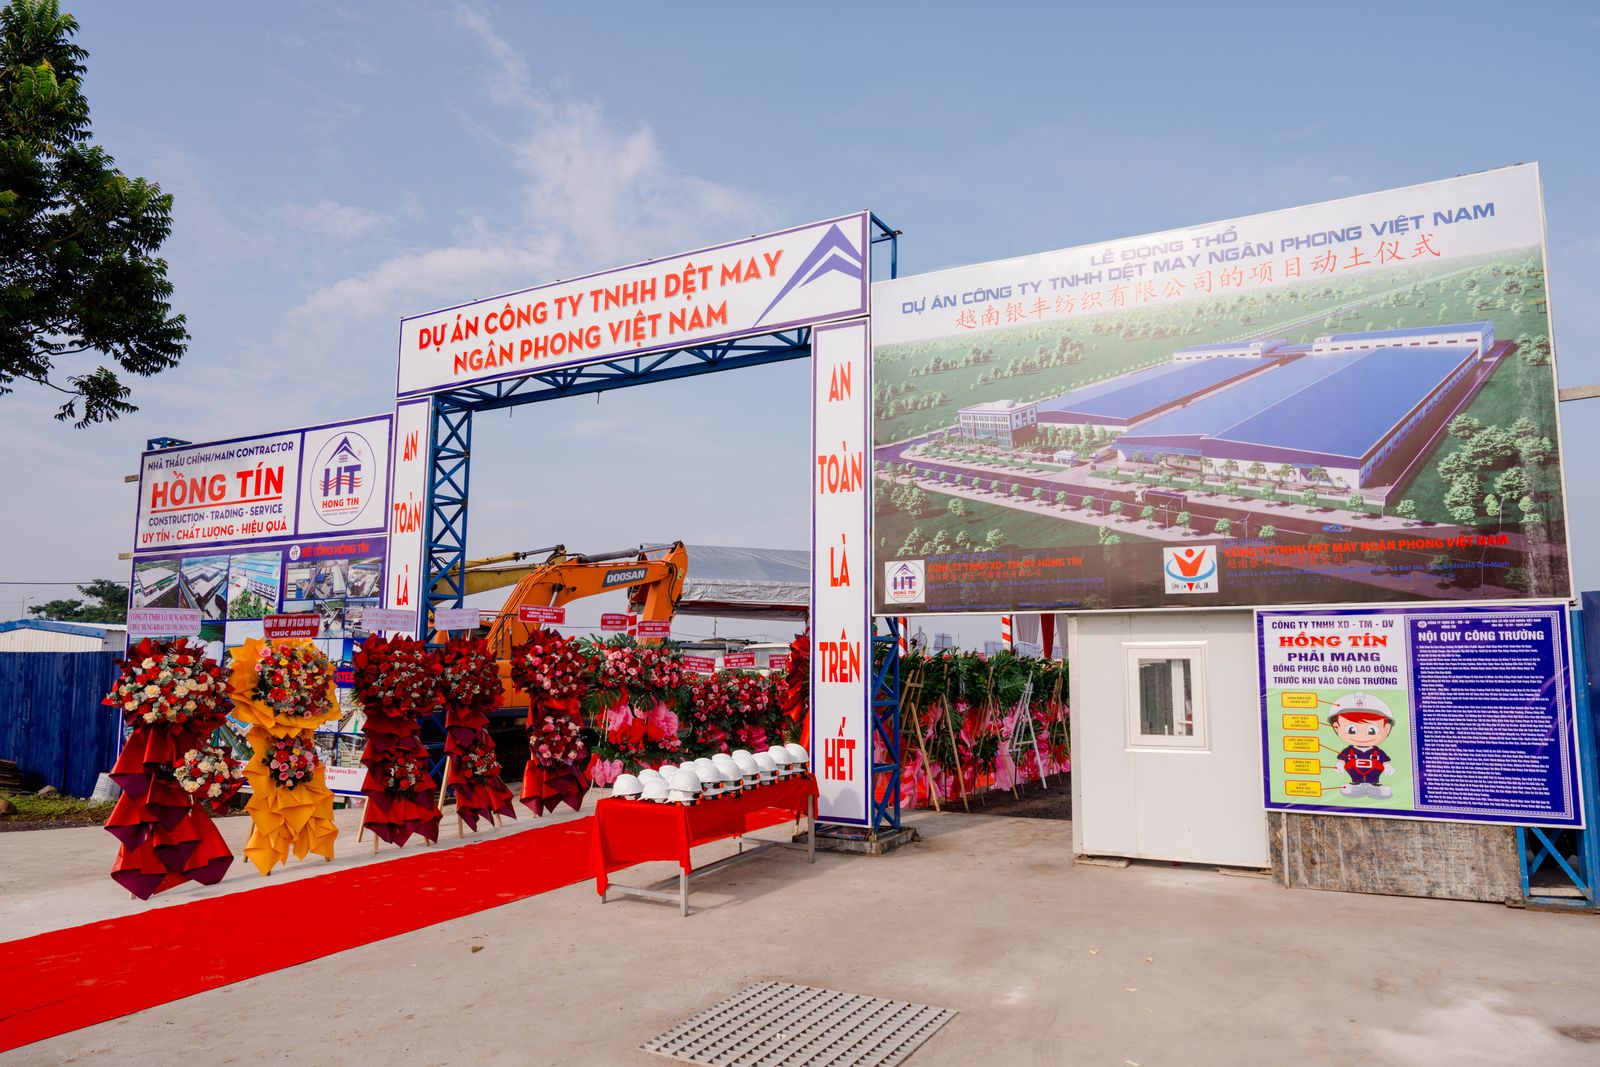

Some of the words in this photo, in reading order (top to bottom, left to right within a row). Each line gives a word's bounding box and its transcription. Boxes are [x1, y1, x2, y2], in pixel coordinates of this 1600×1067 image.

[902, 297, 926, 315] DỰ
[931, 294, 957, 311] ÁN
[962, 286, 1012, 305] CÔNG
[1018, 280, 1042, 296] TY
[1049, 270, 1102, 291] TNHH
[1108, 262, 1147, 282] DỆT
[1153, 253, 1200, 274] MAY
[1208, 241, 1273, 265] NGÂN
[1280, 226, 1362, 252] PHONG
[1370, 214, 1424, 237] VIỆT
[1433, 202, 1495, 226] NAM
[1091, 248, 1114, 267] LỄ
[1120, 240, 1183, 262] ĐỘNG
[1191, 226, 1237, 249] THỔ
[955, 233, 1441, 329] 越南银丰纺织有限公司的项目动土仪式
[419, 322, 447, 352] DỰ
[450, 314, 479, 343] ÁN
[484, 301, 548, 335] CÔNG
[554, 292, 584, 320] TY
[590, 277, 657, 313] TNHH
[664, 262, 713, 301] DỆT
[720, 250, 784, 287] MAY
[453, 339, 514, 375] NGÂN
[519, 325, 601, 362] PHONG
[608, 309, 662, 347] VIỆT
[669, 299, 728, 335] NAM
[829, 362, 852, 402] AN
[236, 441, 294, 458] CONTRACTOR
[403, 430, 418, 462] AN
[151, 470, 227, 509] HỒNG
[236, 462, 284, 498] TÍN
[818, 441, 863, 494] TOÀN
[149, 512, 205, 527] CONSTRUCTION
[210, 508, 244, 521] TRADING
[250, 504, 283, 517] SERVICE
[322, 499, 344, 509] HONG
[394, 492, 422, 534] TOÀN
[142, 533, 155, 544] UY
[156, 528, 170, 543] TÍN
[176, 523, 200, 541] CHẤT
[241, 521, 263, 537] HIỆU
[266, 516, 287, 532] QUẢ
[1332, 542, 1357, 553] MAY
[1360, 539, 1395, 552] NGÂN
[1398, 537, 1445, 549] PHONG
[1445, 535, 1474, 549] VIỆT
[1477, 534, 1509, 547] NAM
[606, 569, 645, 583] DOOSAN
[830, 533, 850, 587] LÀ
[396, 564, 409, 606] LÀ
[1272, 619, 1295, 629] CÔNG
[1298, 621, 1308, 629] TY
[1311, 620, 1334, 629] TNHH
[1359, 620, 1372, 628] TM
[1279, 631, 1342, 648] HỒNG
[1348, 632, 1388, 647] TÍN
[1418, 630, 1437, 644] NỘI
[1440, 631, 1461, 643] QUY
[1465, 629, 1496, 641] CÔNG
[1499, 628, 1545, 641] TRƯỜNG
[819, 627, 860, 683] TRÊN
[1287, 649, 1324, 661] PHẢI
[1330, 652, 1381, 661] MANG
[1298, 664, 1319, 674] PHỤC
[1356, 665, 1371, 673] LAO
[1374, 663, 1398, 675] ĐỘNG
[1302, 676, 1316, 685] KHI
[1338, 675, 1360, 685] CÔNG
[1362, 675, 1398, 686] TRƯỜNG
[825, 717, 856, 781] HẾT
